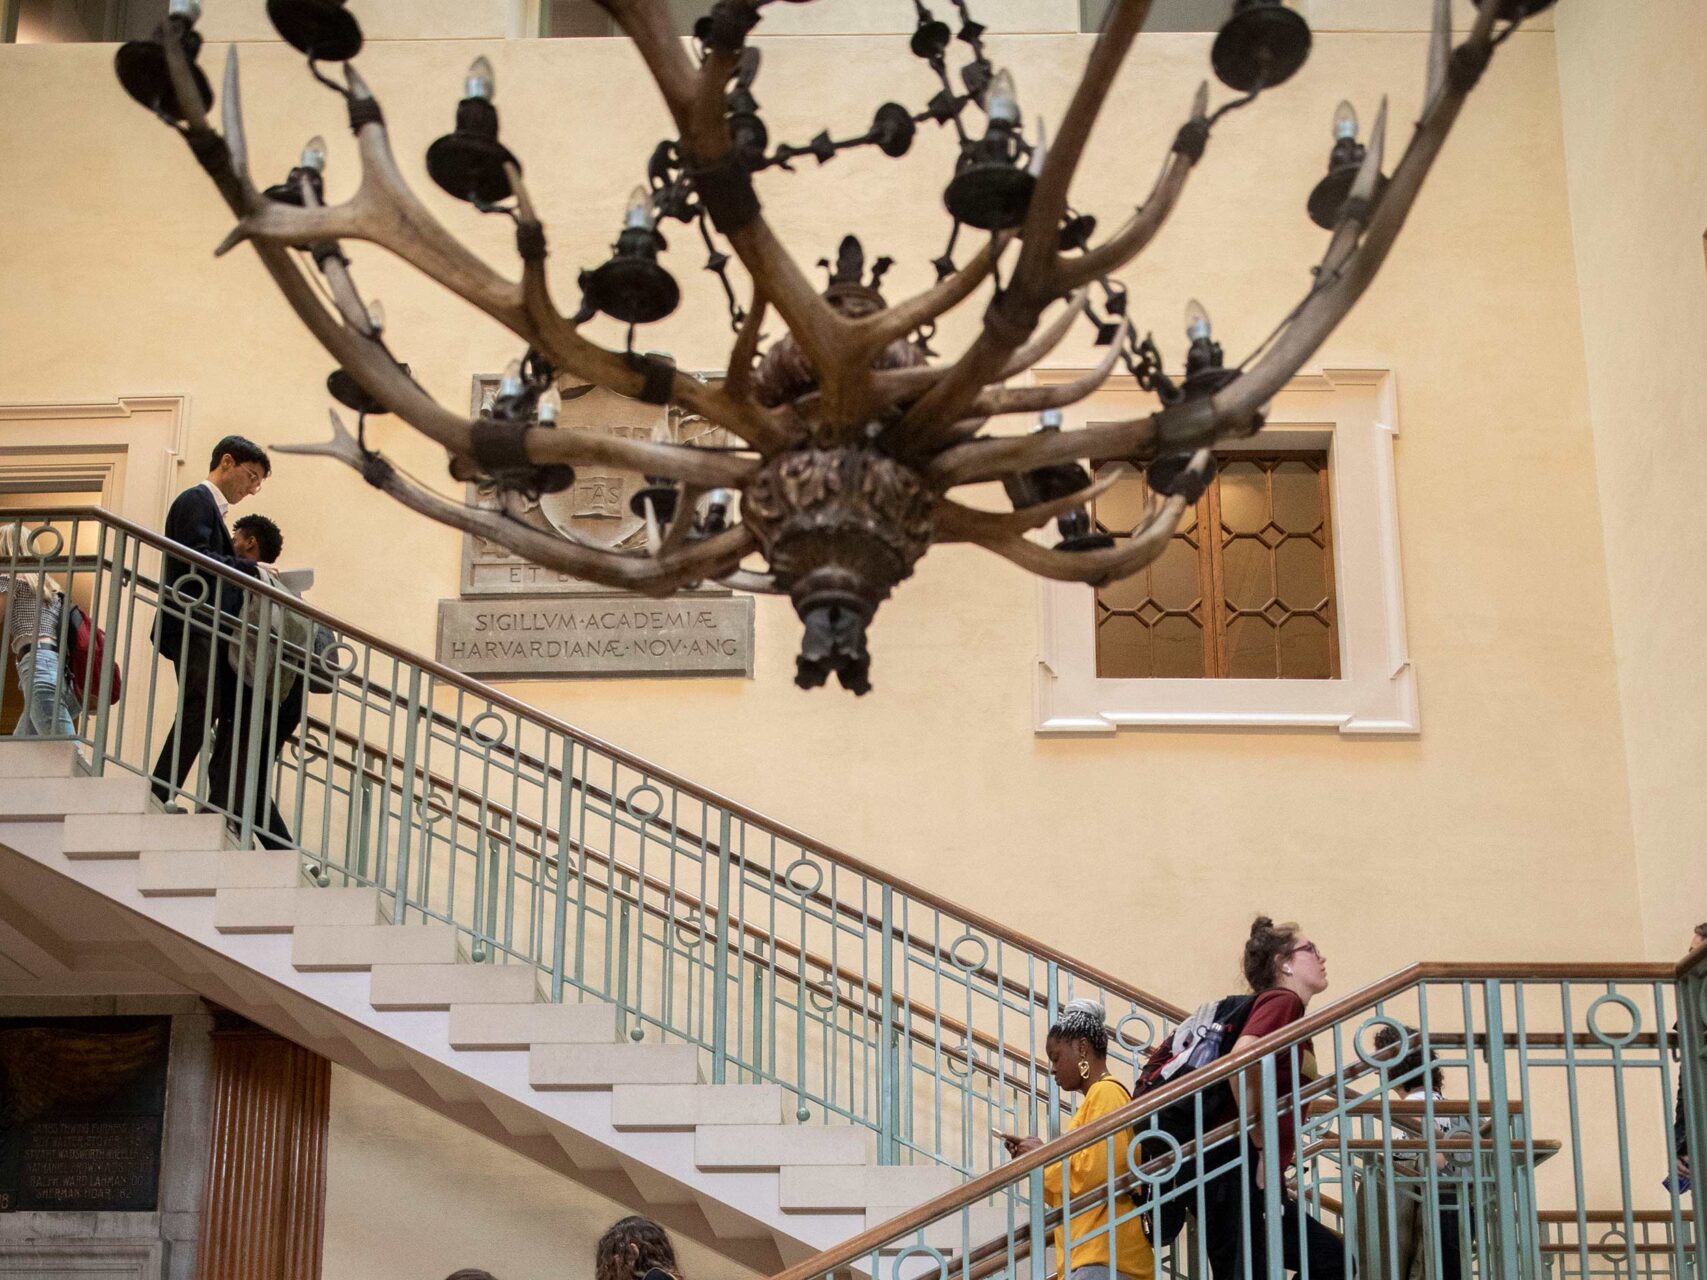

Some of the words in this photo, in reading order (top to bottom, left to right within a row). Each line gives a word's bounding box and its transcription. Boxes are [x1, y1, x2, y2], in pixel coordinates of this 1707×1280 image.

[510, 567, 541, 582] ET
[475, 613, 578, 631] SIGILLVM
[634, 638, 682, 656] NOV
[687, 638, 737, 656] ANG
